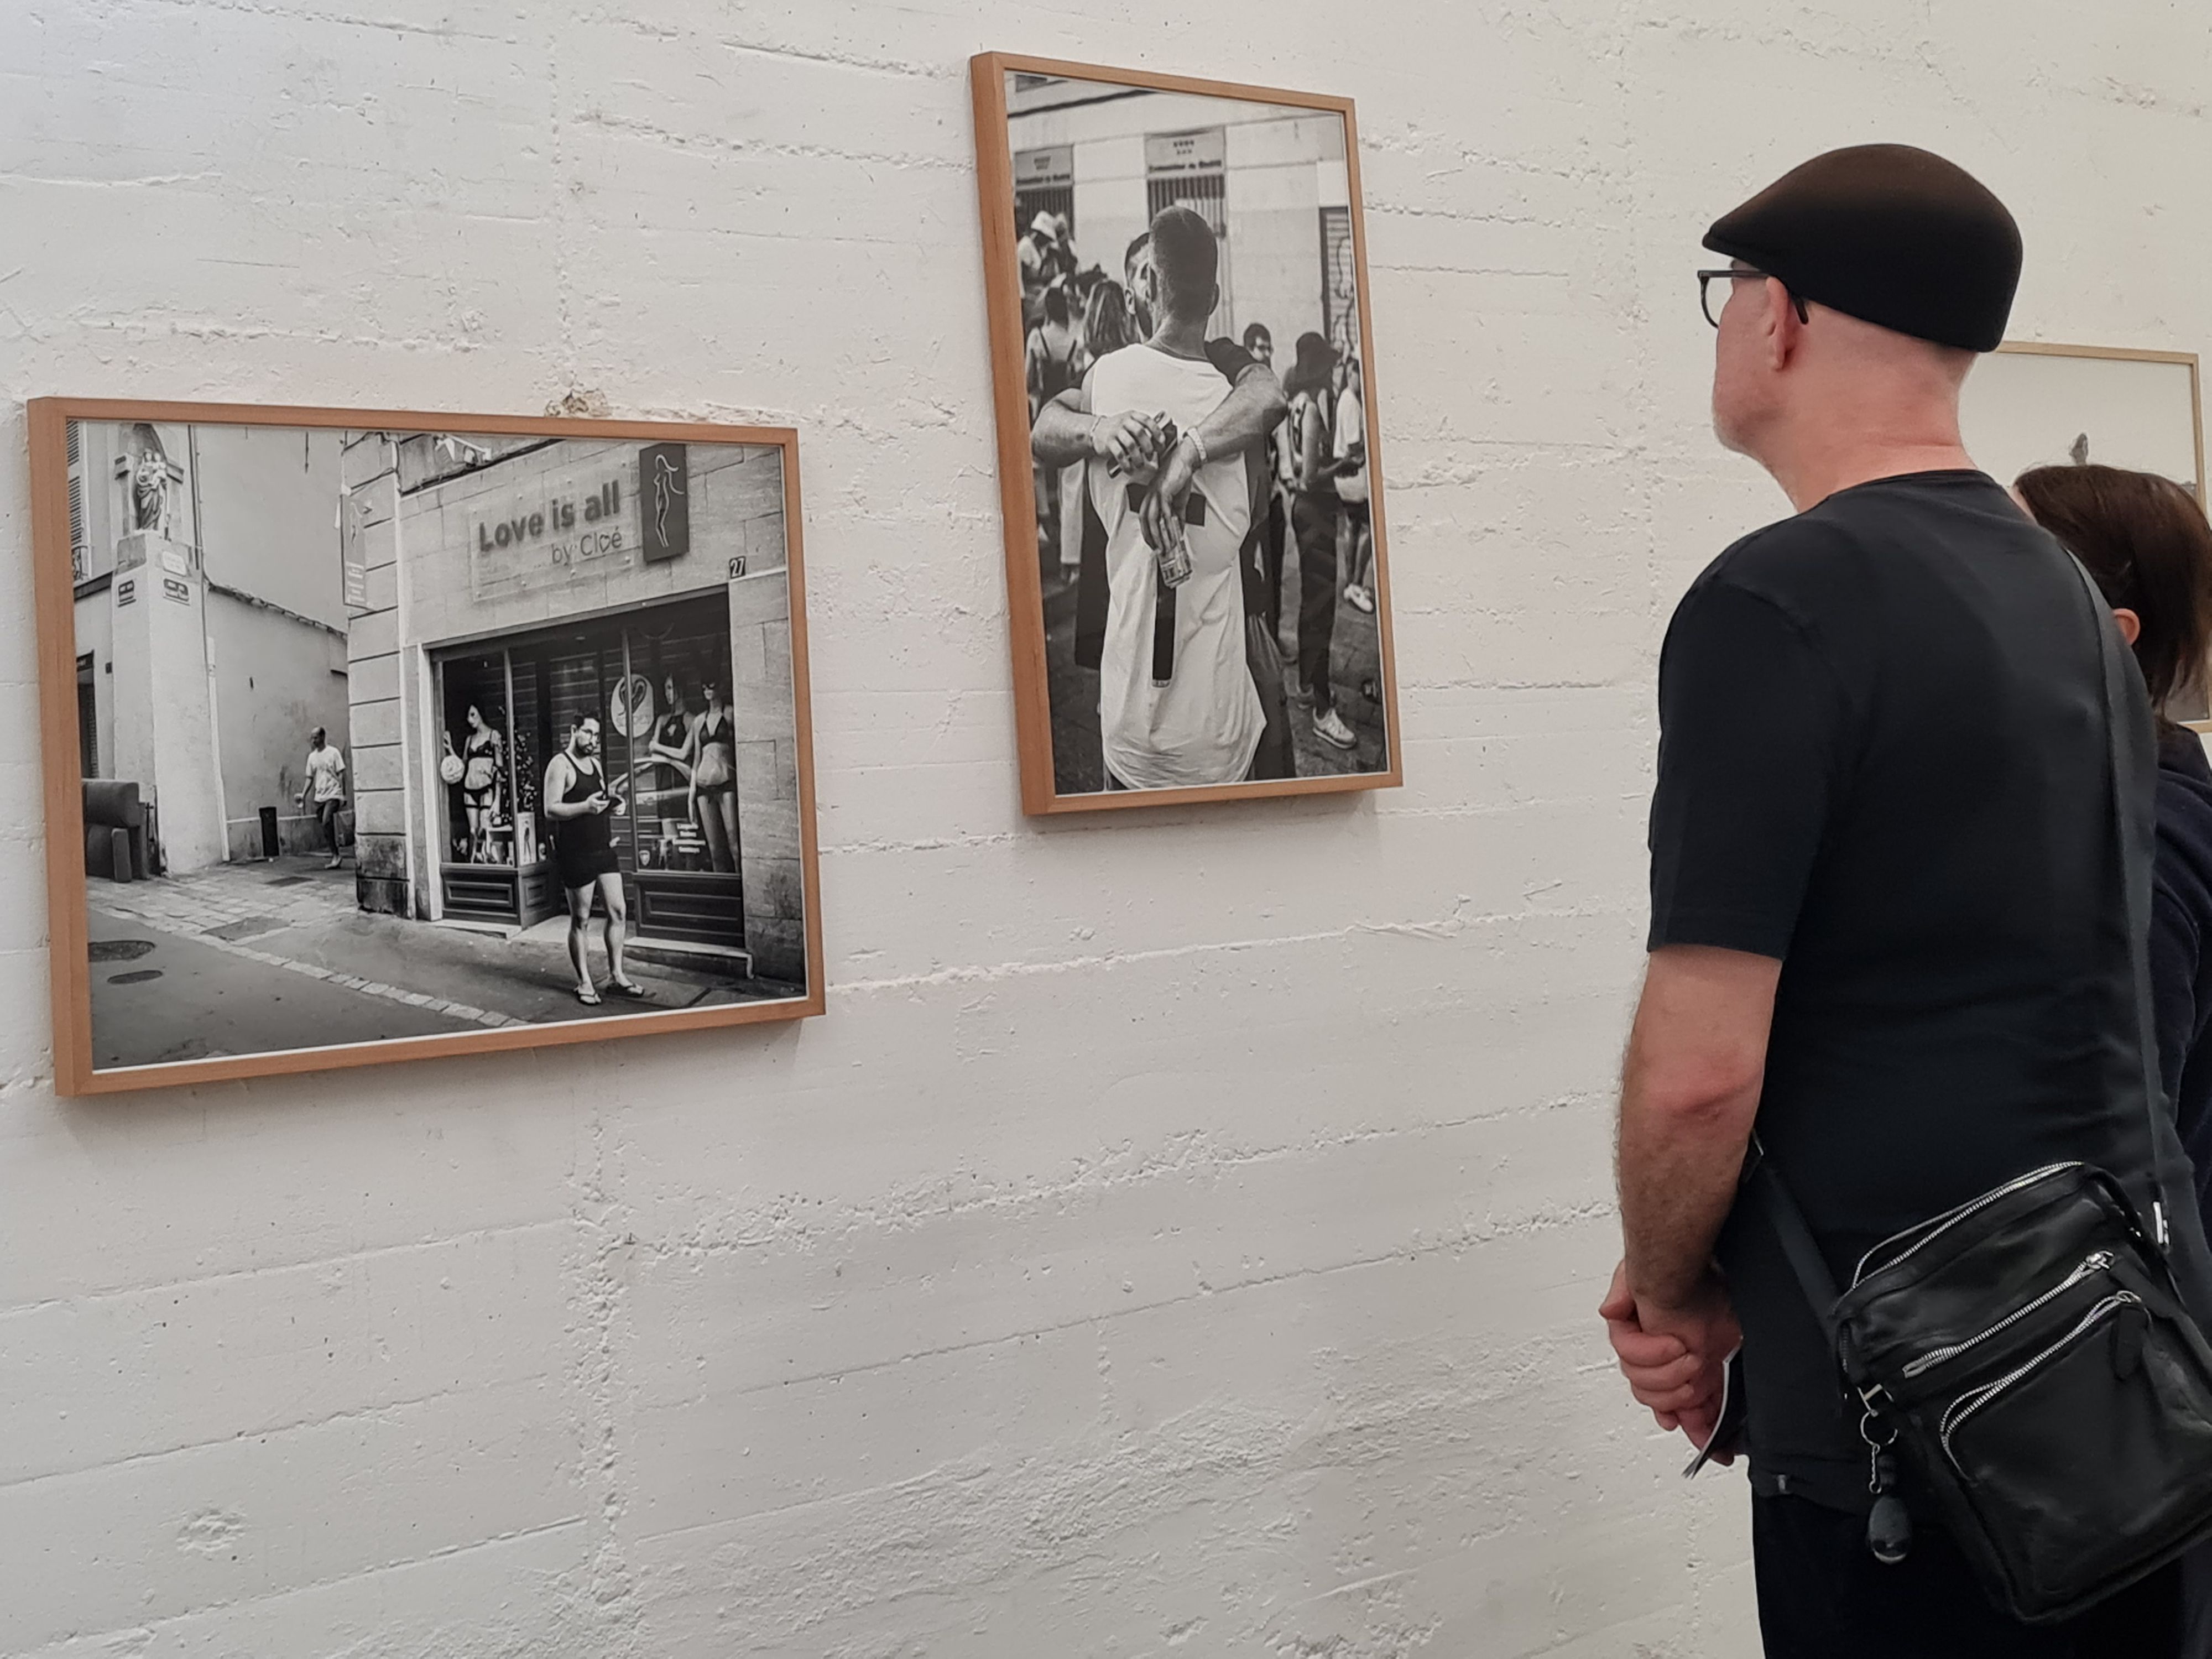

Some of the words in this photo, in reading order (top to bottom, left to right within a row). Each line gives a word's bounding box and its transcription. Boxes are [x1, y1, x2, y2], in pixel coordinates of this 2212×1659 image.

[479, 512, 545, 552] Love
[551, 498, 575, 530] is
[584, 479, 620, 522] all
[551, 543, 573, 566] by
[730, 557, 744, 578] 27
